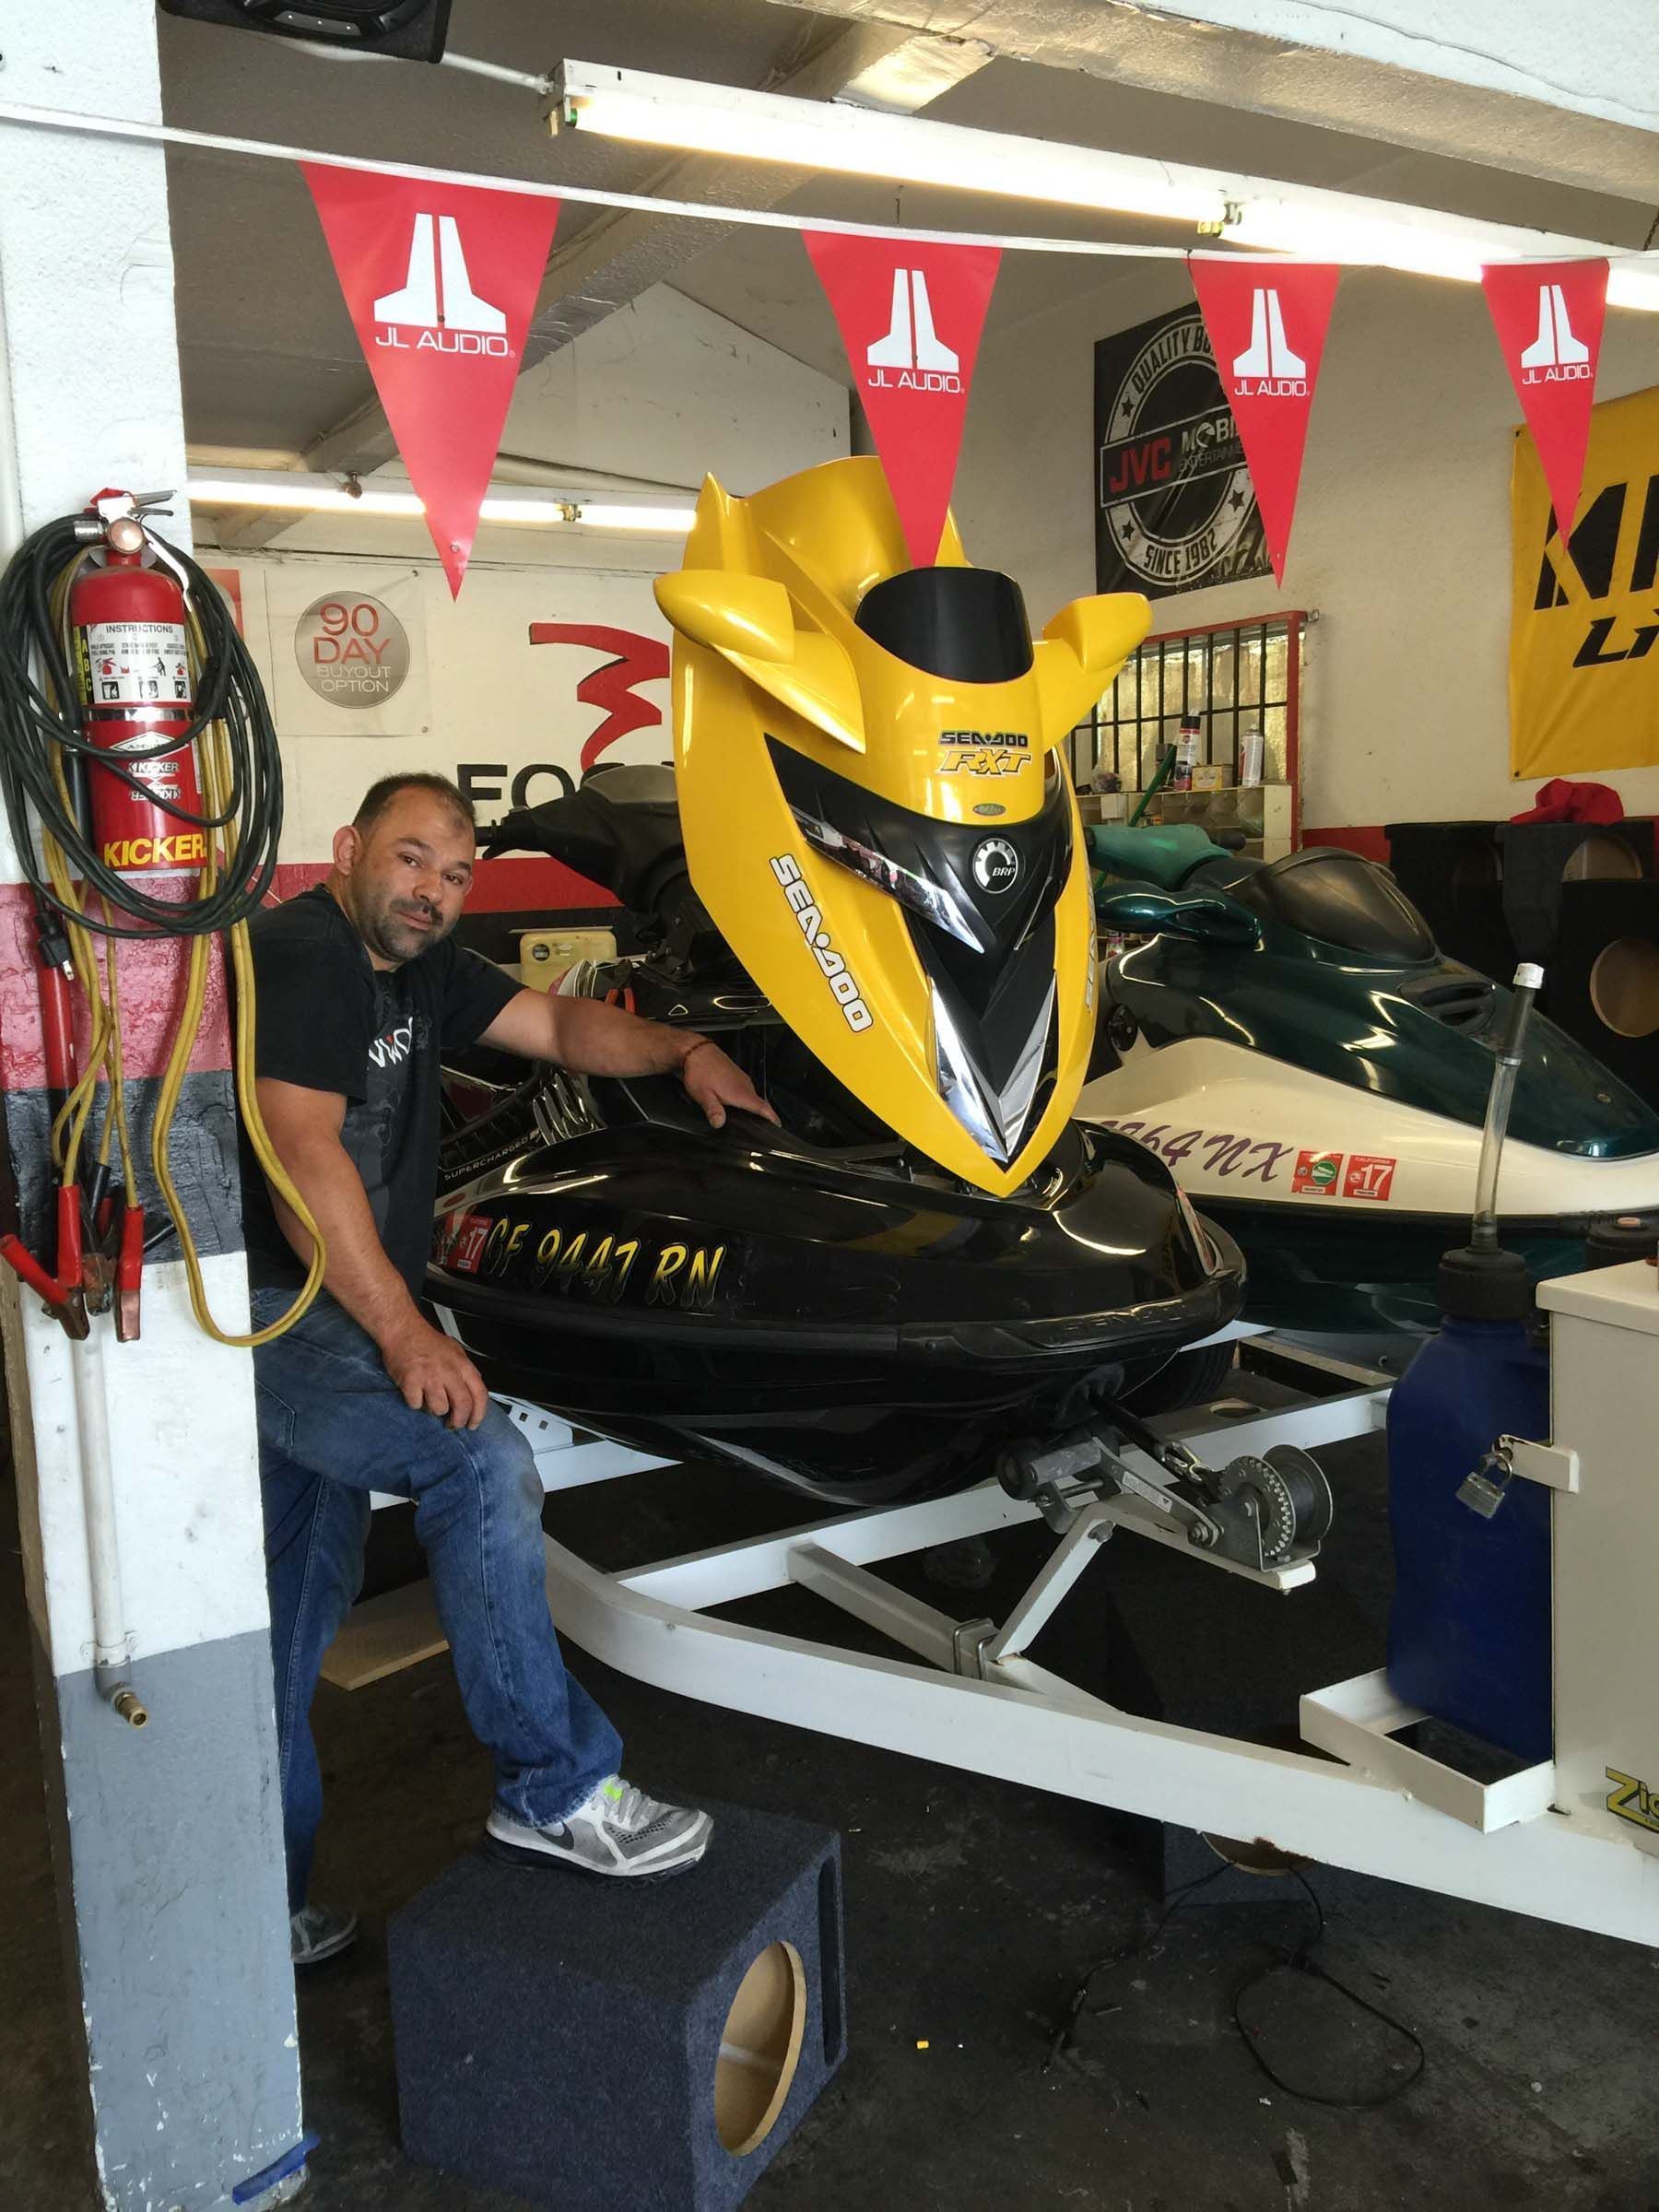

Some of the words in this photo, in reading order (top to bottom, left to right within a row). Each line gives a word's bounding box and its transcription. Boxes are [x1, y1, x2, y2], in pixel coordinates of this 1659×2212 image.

[374, 326, 410, 348] JL
[417, 330, 509, 357] AUDIO
[1131, 326, 1192, 394] QUALITY
[1523, 369, 1542, 384] JL
[1544, 364, 1591, 382] AUDIO
[867, 369, 894, 387] JL
[898, 371, 960, 394] AUDIO
[1234, 379, 1254, 395] JL
[1256, 380, 1307, 396] AUDIO
[1110, 437, 1173, 494] JVC
[1181, 418, 1240, 455] MOBI
[1143, 544, 1182, 575] SINCE
[1185, 529, 1219, 571] 1982
[106, 624, 173, 634] INSTRUCTIONS
[319, 602, 380, 636] 90
[312, 636, 392, 665] DAY
[316, 665, 392, 679] BUYOUT
[321, 678, 390, 693] OPTION
[938, 747, 1032, 776] RXT
[104, 832, 207, 868] KICKER
[992, 866, 1016, 877] BRP
[1361, 1163, 1394, 1192] 17
[464, 1227, 489, 1260] 17
[535, 1227, 641, 1306] 9447
[647, 1241, 726, 1310] RN
